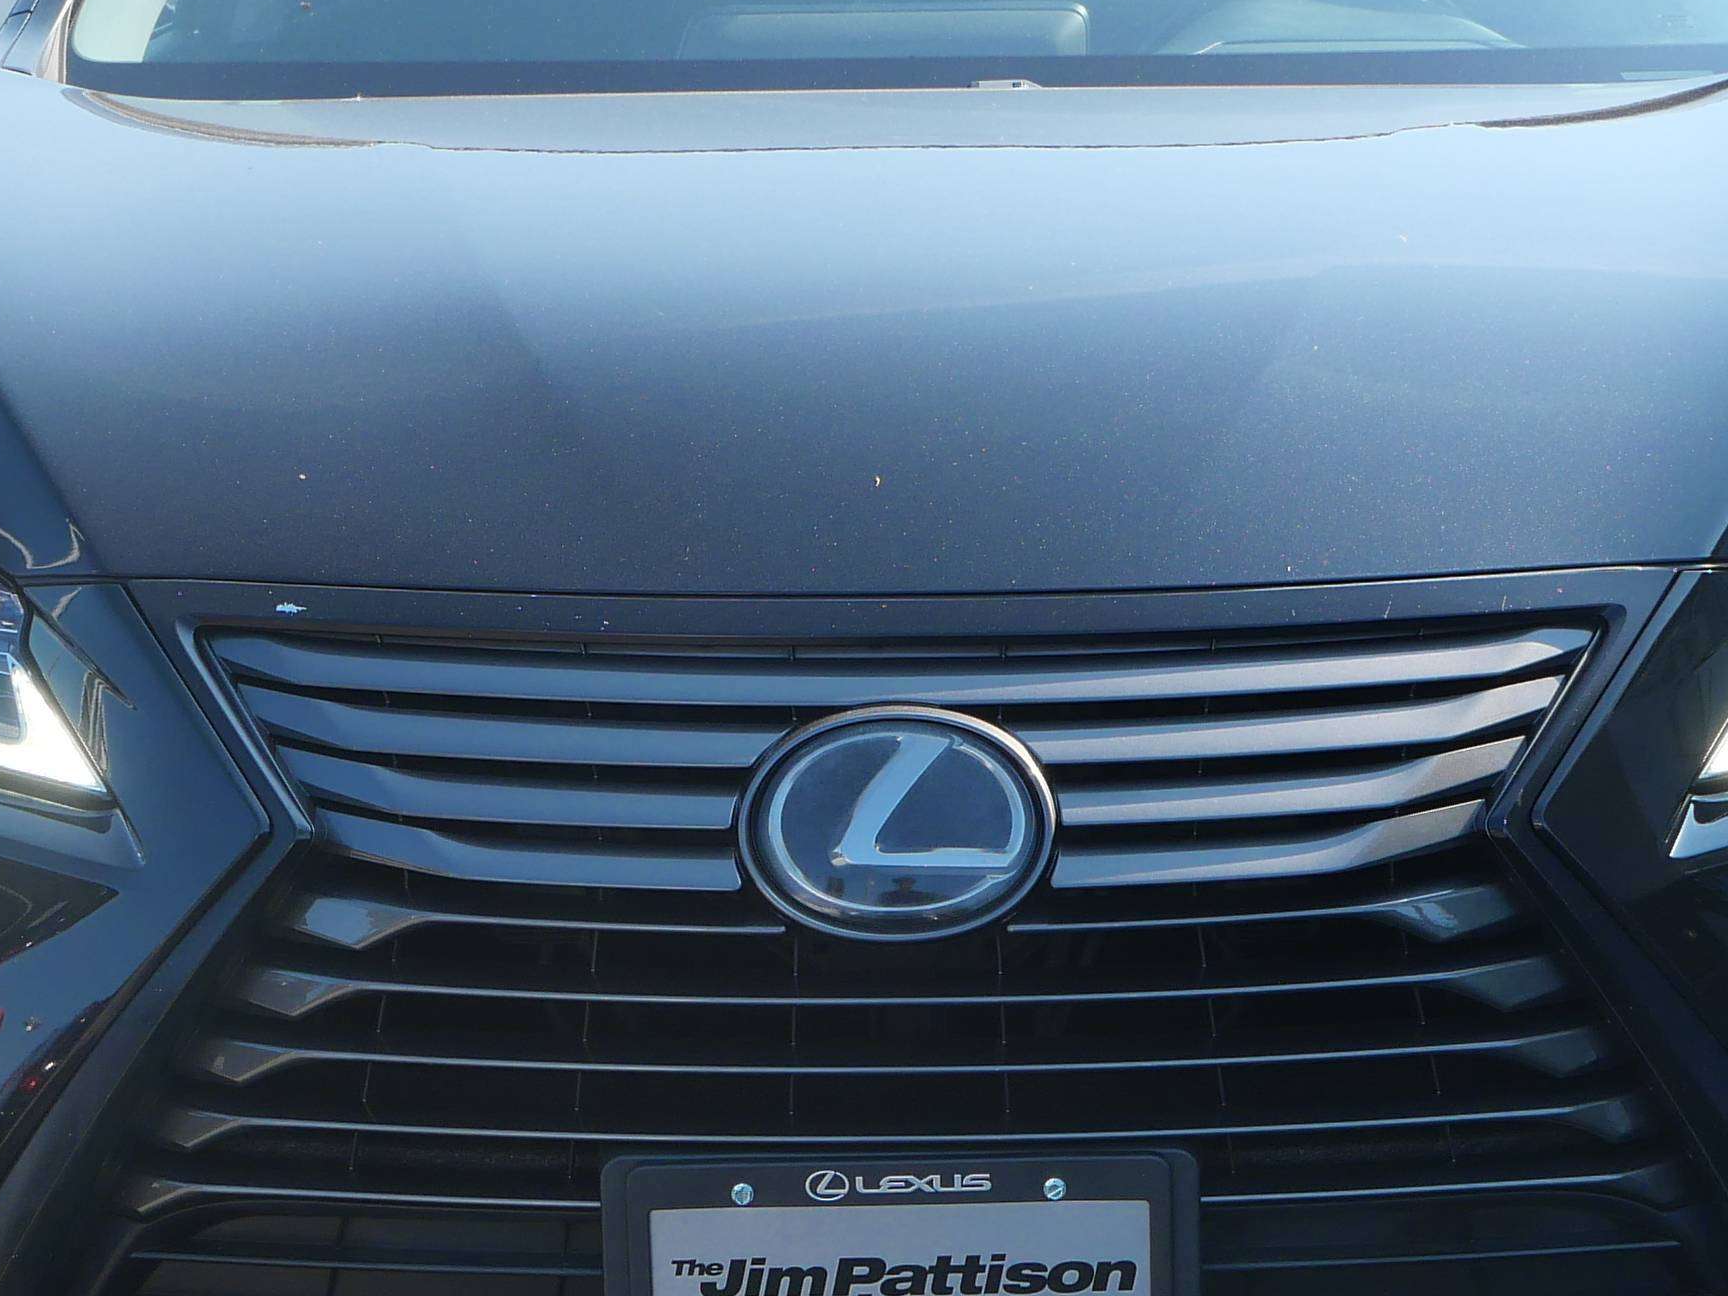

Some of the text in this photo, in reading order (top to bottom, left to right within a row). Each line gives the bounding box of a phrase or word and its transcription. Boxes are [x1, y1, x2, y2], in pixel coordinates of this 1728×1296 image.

[856, 1173, 992, 1195] LEXUS
[672, 1259, 724, 1277] The
[832, 1254, 1138, 1296] Pattison
